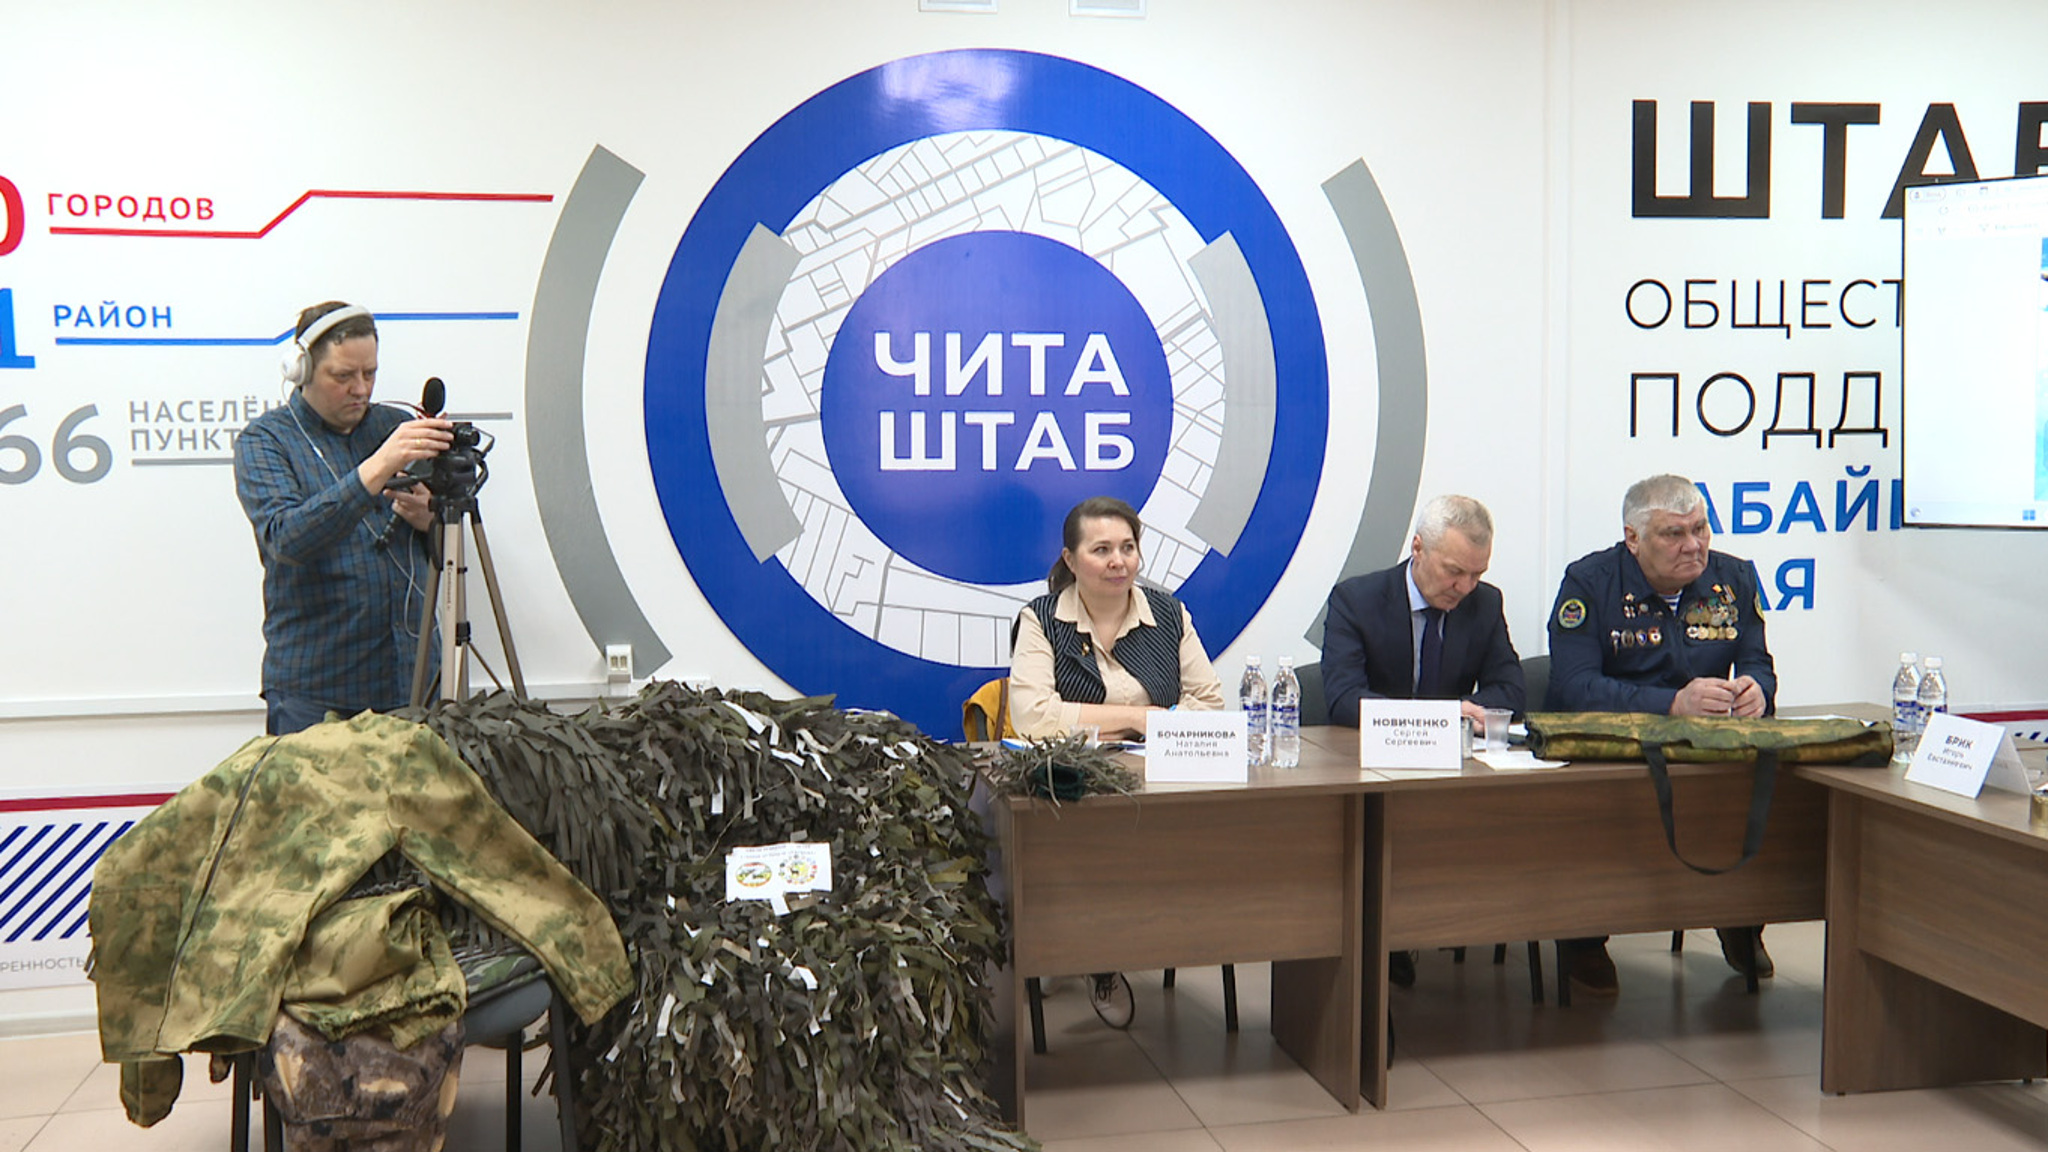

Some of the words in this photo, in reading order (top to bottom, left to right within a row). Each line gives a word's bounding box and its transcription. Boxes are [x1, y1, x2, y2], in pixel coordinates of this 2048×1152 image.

[48, 192, 215, 222] ГОРОДОВ
[53, 300, 172, 328] РАЙОН
[874, 331, 1131, 396] ЧИТА
[1630, 372, 1888, 449] ПОДД
[130, 428, 241, 450] ПУНКТ
[878, 411, 1136, 472] ШТАБ
[1372, 717, 1449, 728] НОВИЧЕНКО
[1157, 730, 1237, 739] БОЧАРНИКОВА
[1393, 728, 1429, 738] Сергей
[1176, 740, 1218, 748] Наталия
[1384, 737, 1438, 747] Сергеевич
[1945, 735, 1974, 749] БРИК
[1164, 749, 1230, 758] Анатольевна
